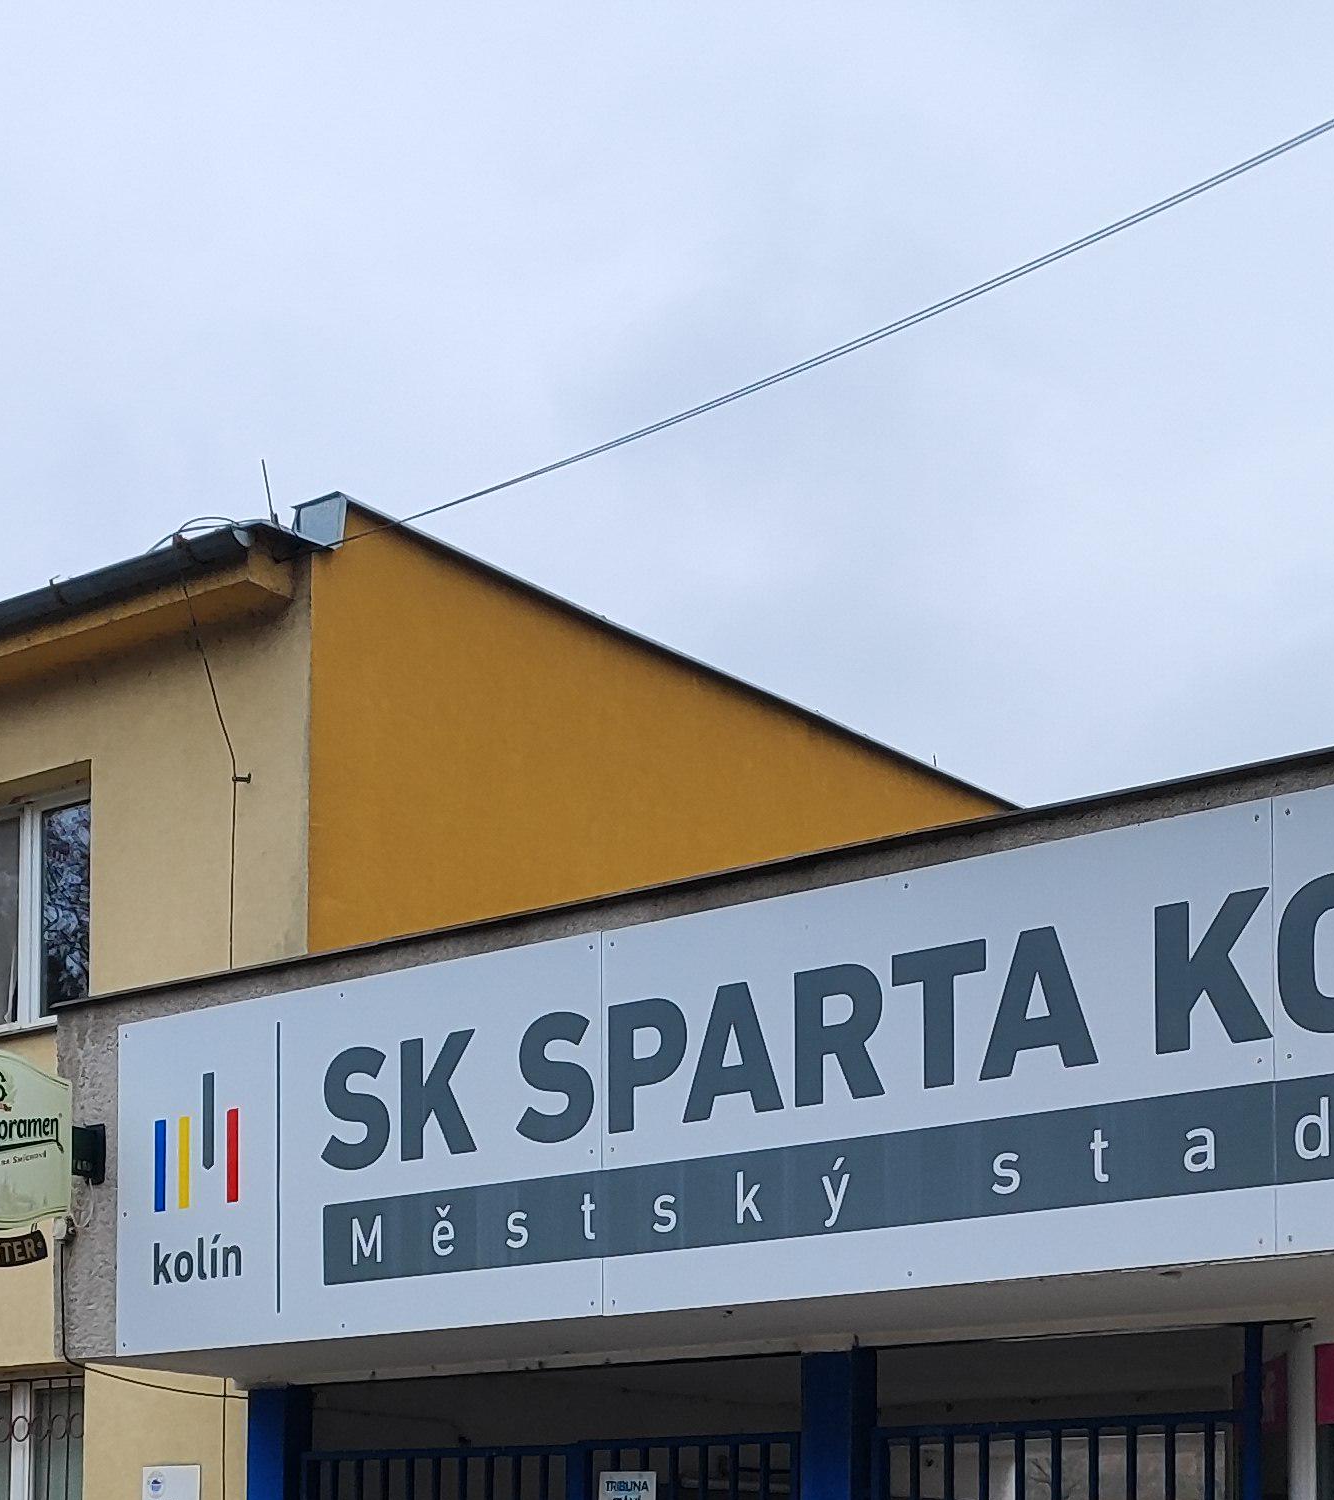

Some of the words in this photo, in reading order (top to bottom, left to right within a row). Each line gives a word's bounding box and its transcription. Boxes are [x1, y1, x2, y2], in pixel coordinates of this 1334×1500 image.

[321, 1028, 478, 1171] SK
[516, 926, 1099, 1144] SPARTA
[351, 1157, 850, 1265] Městský
[152, 1233, 243, 1286] kolín
[605, 1480, 649, 1492] TRIBUNA
